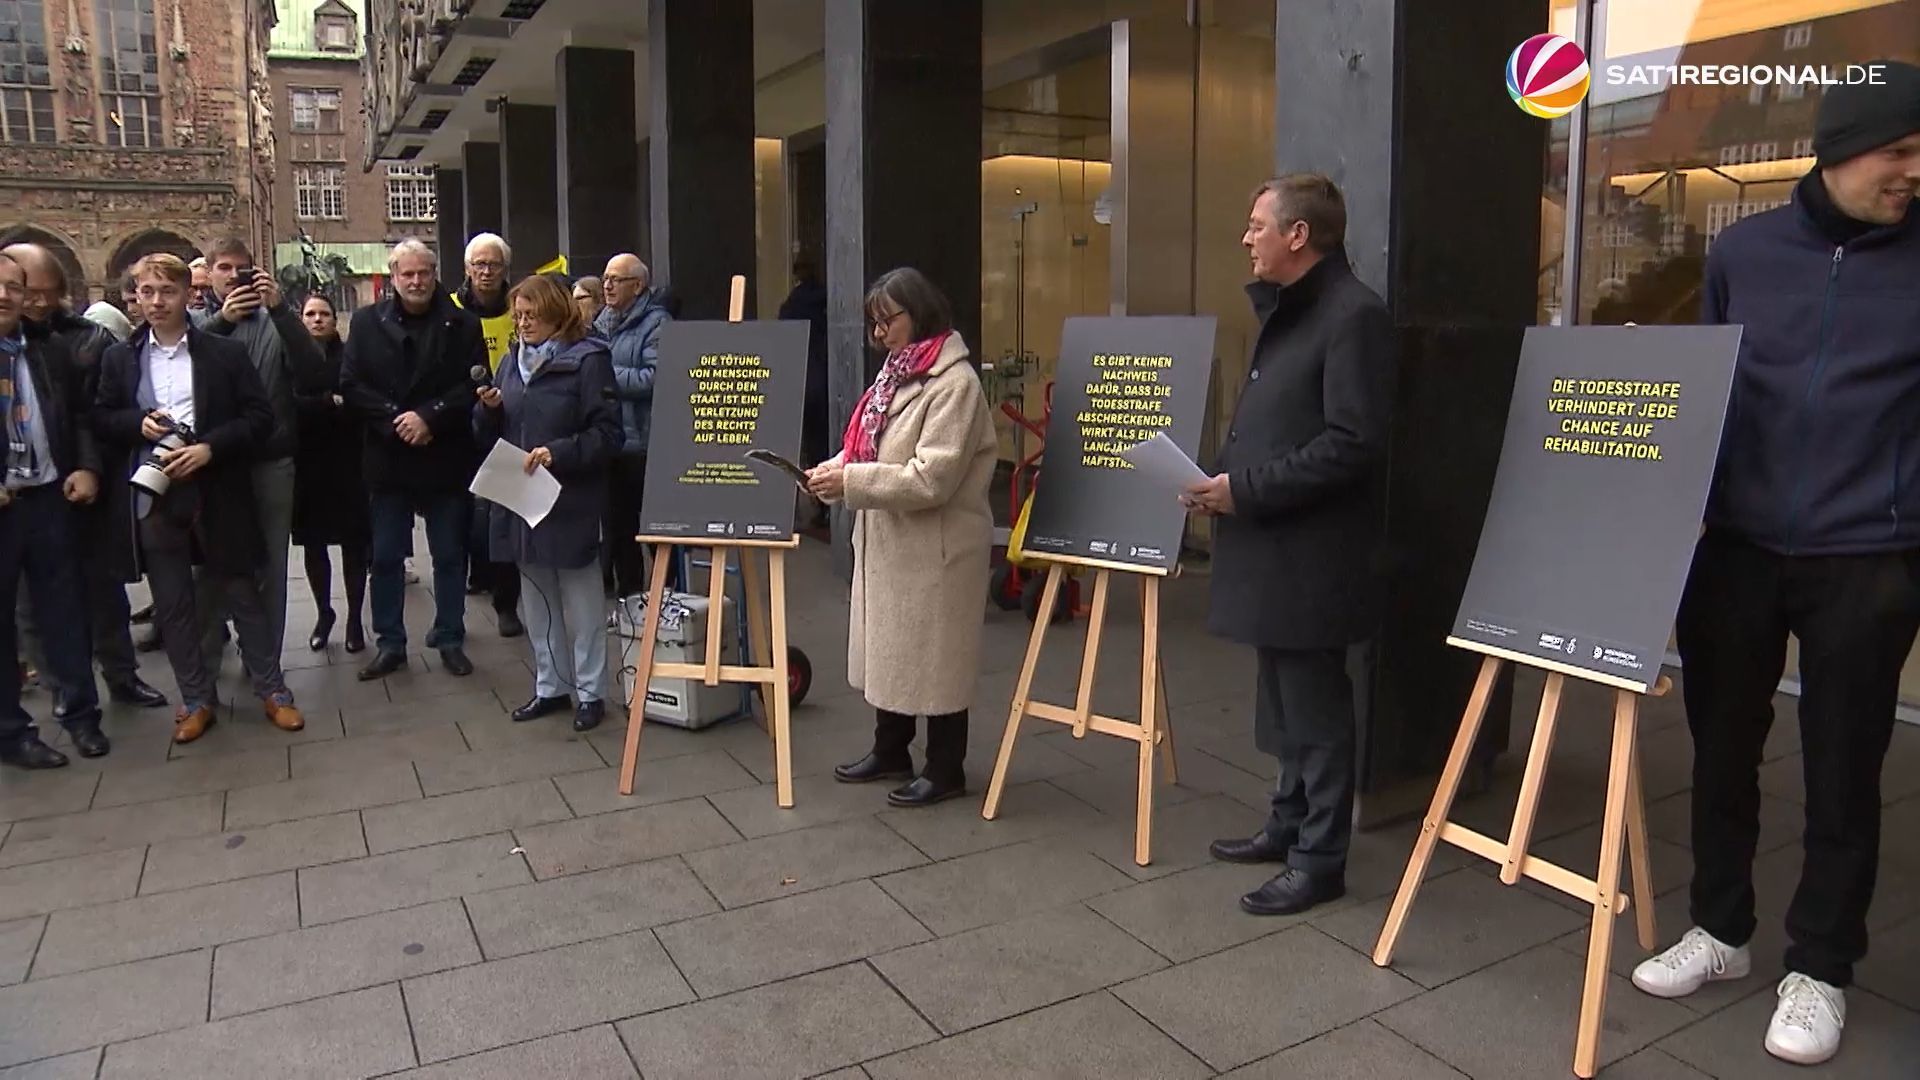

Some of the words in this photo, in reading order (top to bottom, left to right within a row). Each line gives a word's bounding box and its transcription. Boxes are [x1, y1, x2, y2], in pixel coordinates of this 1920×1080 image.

[700, 355, 717, 366] DIE
[720, 353, 761, 366] TÖTUNG
[1093, 355, 1106, 366] ES
[1108, 355, 1132, 367] GIBT
[1133, 356, 1173, 367] KEINEN
[689, 369, 710, 378] VON
[712, 369, 770, 379] MENSCHEN
[1102, 370, 1158, 382] NACHWEIS
[699, 381, 734, 392] DURCH
[736, 382, 758, 392] DEN
[1085, 382, 1121, 396] DAFÜR,
[1124, 385, 1151, 396] DASS
[1153, 386, 1172, 397] DIE
[1552, 378, 1576, 394] DIE
[1579, 380, 1681, 398] TODESSTRAFE
[690, 394, 720, 404] STAAT
[723, 395, 739, 404] IST
[741, 395, 765, 404] EINE
[1091, 398, 1162, 412] TODESSTRAFE
[693, 407, 759, 418] VERLETZUNG
[1547, 399, 1636, 416] VERHINDERT
[1638, 403, 1679, 418] JEDE
[694, 420, 713, 430] DES
[716, 420, 756, 431] RECHTS
[1076, 411, 1172, 427] ABSCHRECKENDER
[1081, 426, 1115, 438] WIRKT
[1116, 429, 1136, 440] ALS
[1138, 429, 1159, 441] EIN
[1561, 419, 1620, 436] CHANCE
[1622, 423, 1654, 438] AUF
[694, 433, 715, 443] AUF
[717, 433, 752, 444] LEBEN.
[1544, 437, 1664, 460] REHABILITATION.
